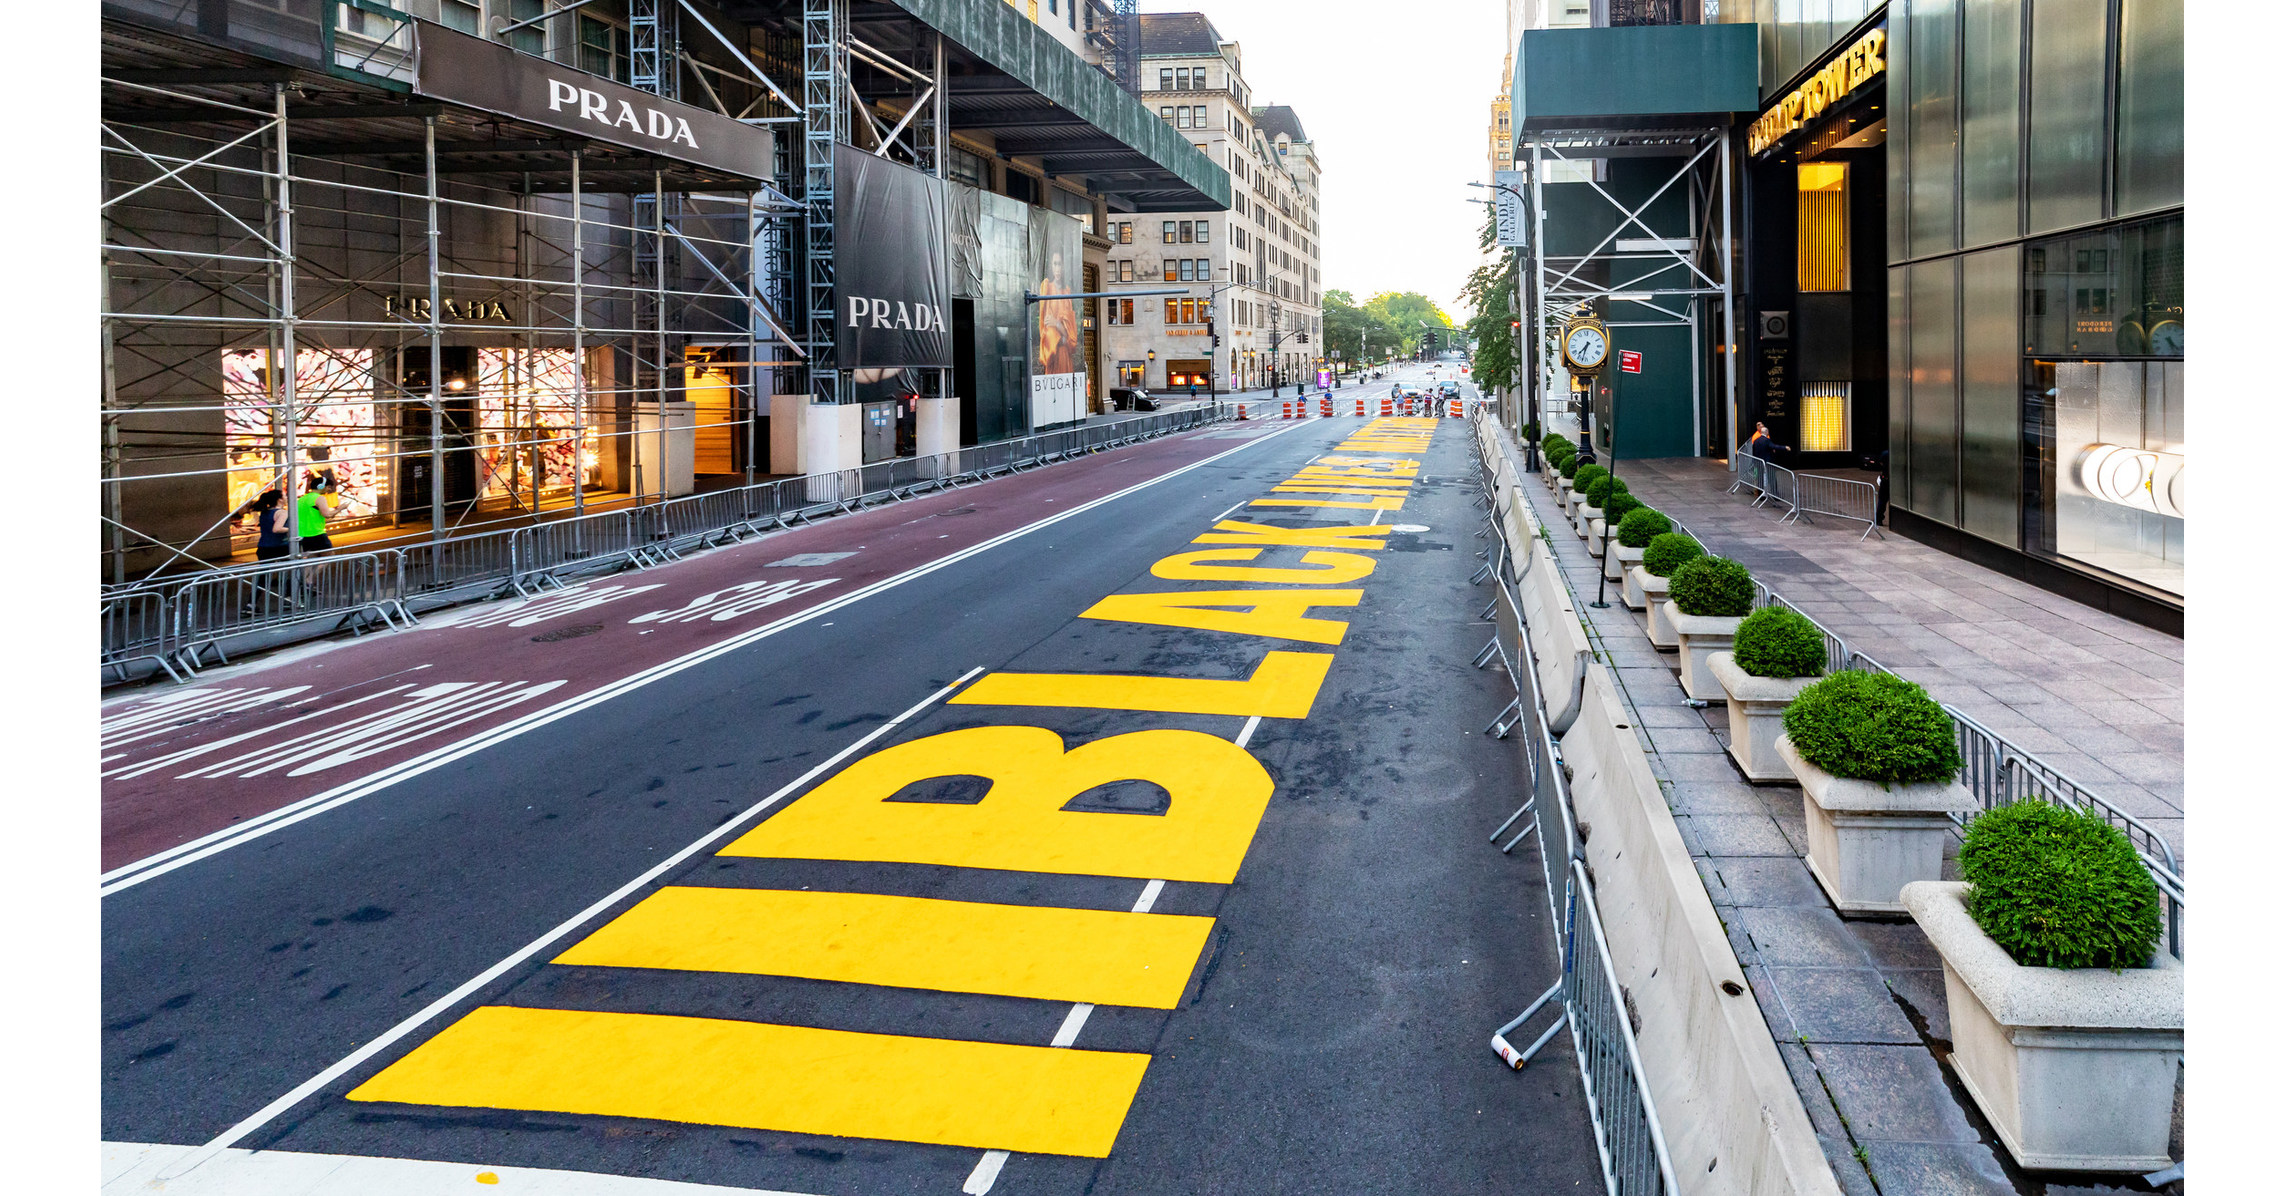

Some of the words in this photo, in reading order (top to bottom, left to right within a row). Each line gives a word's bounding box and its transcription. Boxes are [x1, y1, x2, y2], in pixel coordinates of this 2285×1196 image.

[1800, 28, 1886, 121] TOWER
[548, 79, 699, 149] PRADA
[1497, 180, 1510, 241] FINDLAY
[386, 295, 513, 321] PRADA
[847, 296, 946, 333] PRADA
[715, 520, 1394, 884] BLACK
[1248, 455, 1421, 511] LIVES
